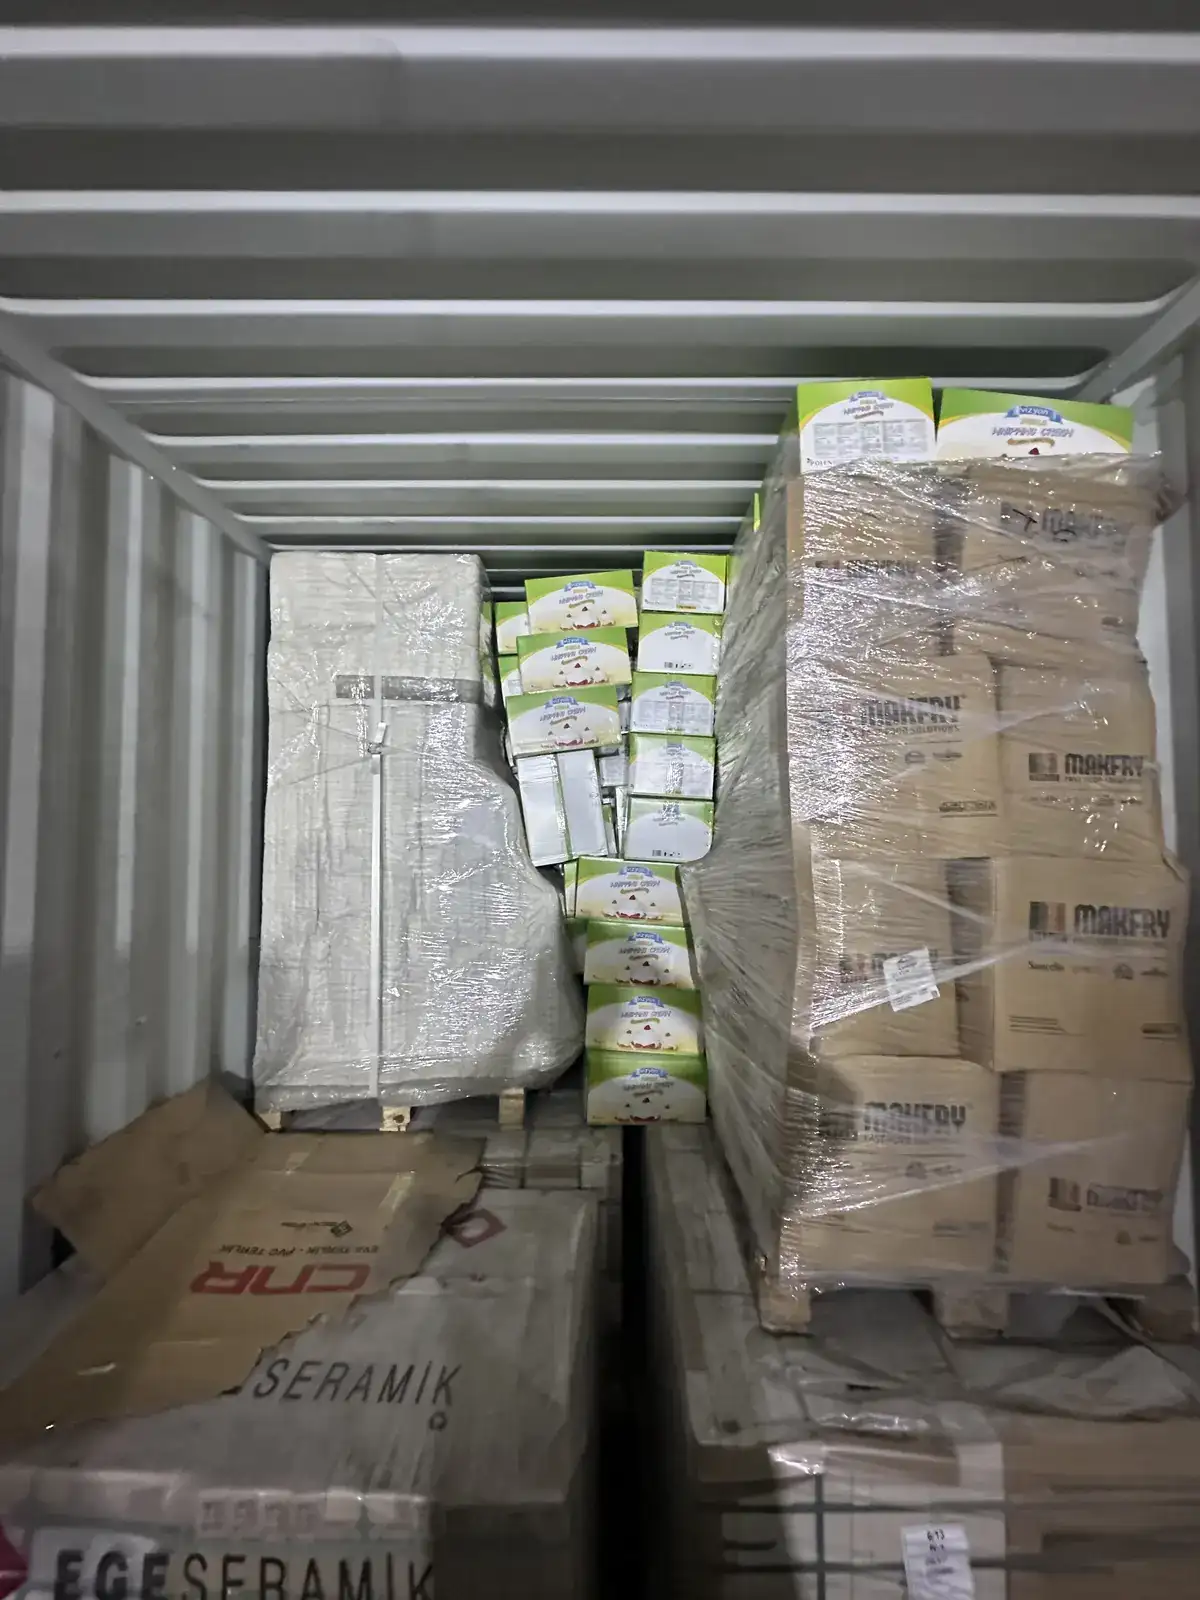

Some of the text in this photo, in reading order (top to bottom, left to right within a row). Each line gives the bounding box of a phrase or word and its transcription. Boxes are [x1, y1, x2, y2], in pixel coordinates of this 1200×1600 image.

[1064, 753, 1144, 777] MAKFRY
[1073, 903, 1171, 939] MAKFRY
[189, 1260, 372, 1296] CNR
[252, 1357, 463, 1405] SERAMİK
